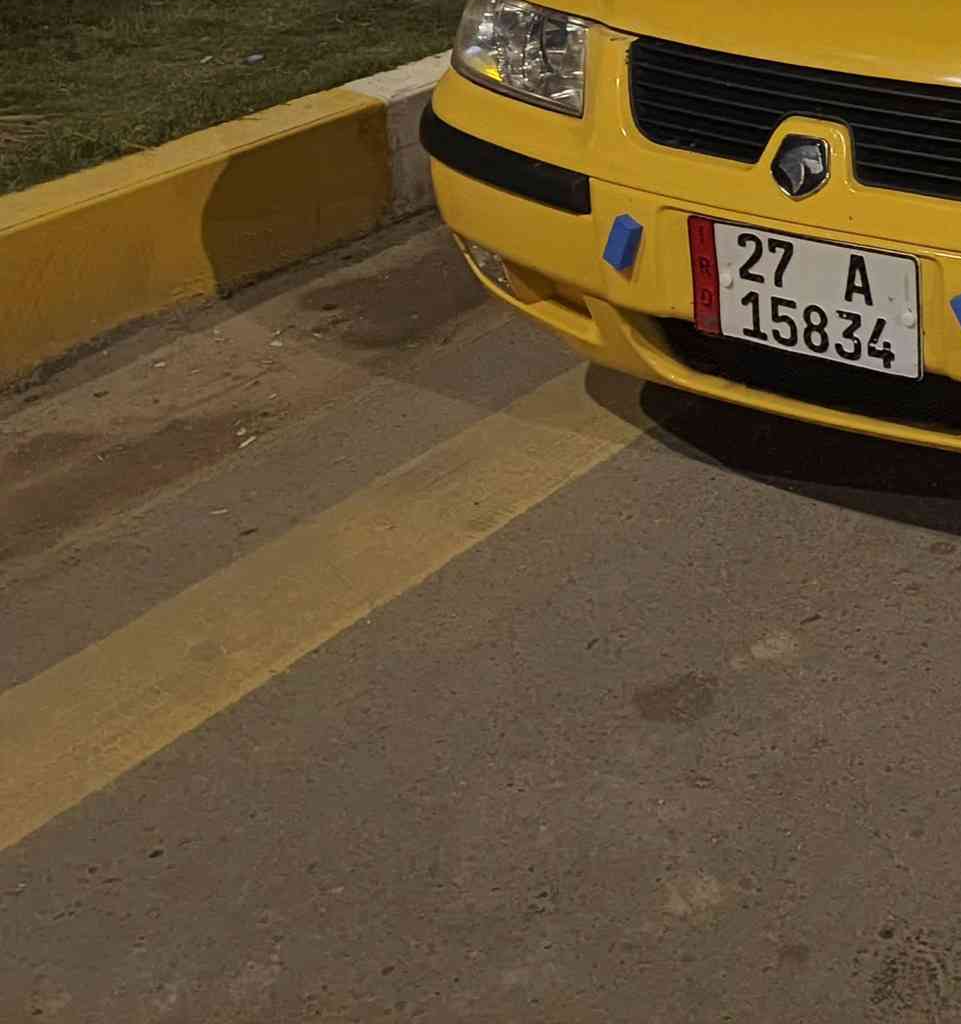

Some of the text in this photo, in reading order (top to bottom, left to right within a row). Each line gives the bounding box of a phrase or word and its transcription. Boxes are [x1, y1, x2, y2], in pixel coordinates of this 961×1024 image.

[737, 232, 873, 306] 27 A
[741, 291, 895, 368] 15834
